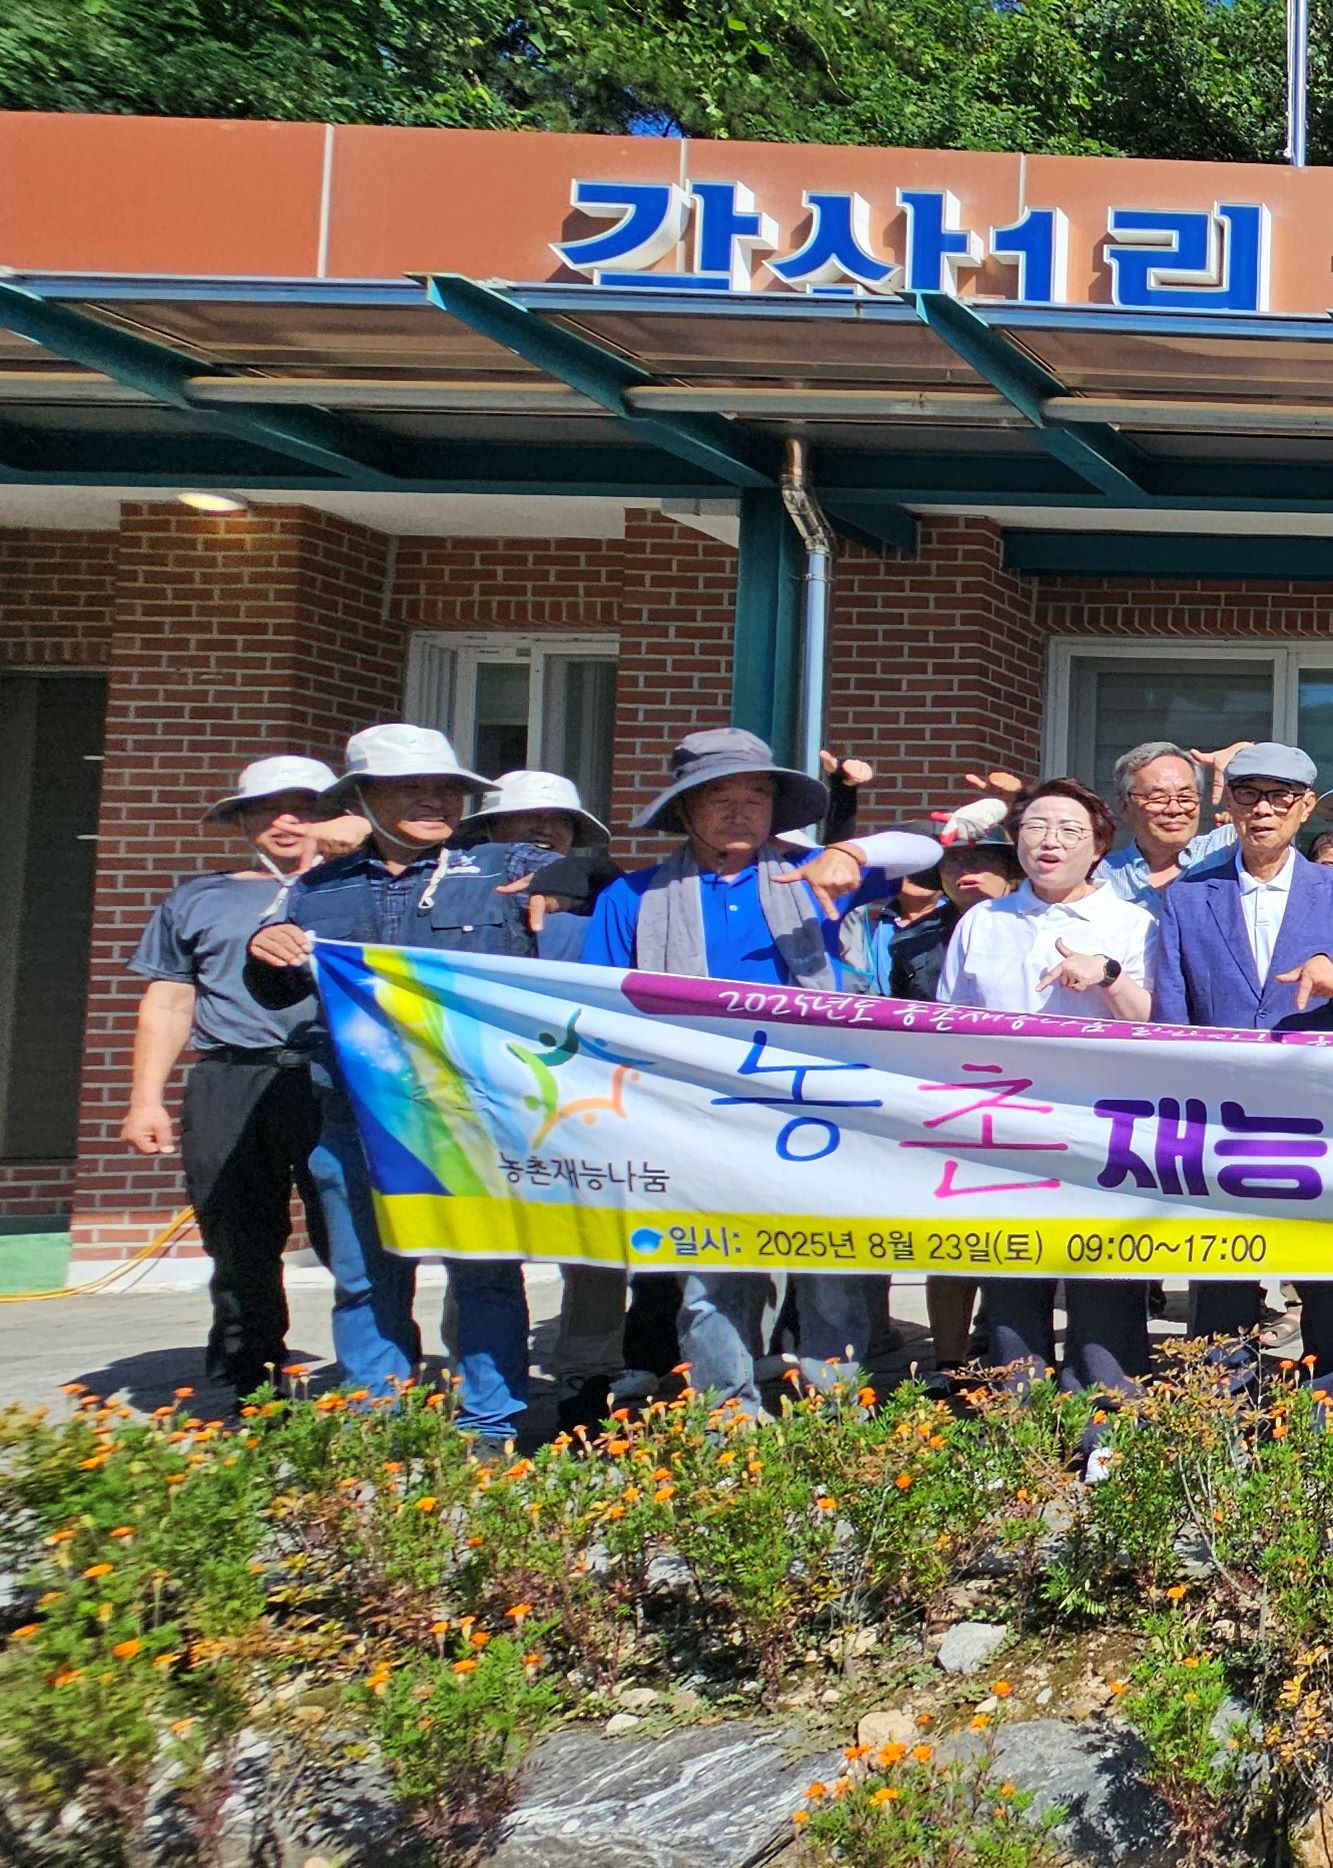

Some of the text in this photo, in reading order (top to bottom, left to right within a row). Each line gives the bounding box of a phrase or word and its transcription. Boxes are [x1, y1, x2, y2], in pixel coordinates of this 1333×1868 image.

[498, 1151, 671, 1193] 농촌재능나눔
[669, 1225, 1267, 1265] 일시: 2025년 8월 23일(토) 09:00~17:00
